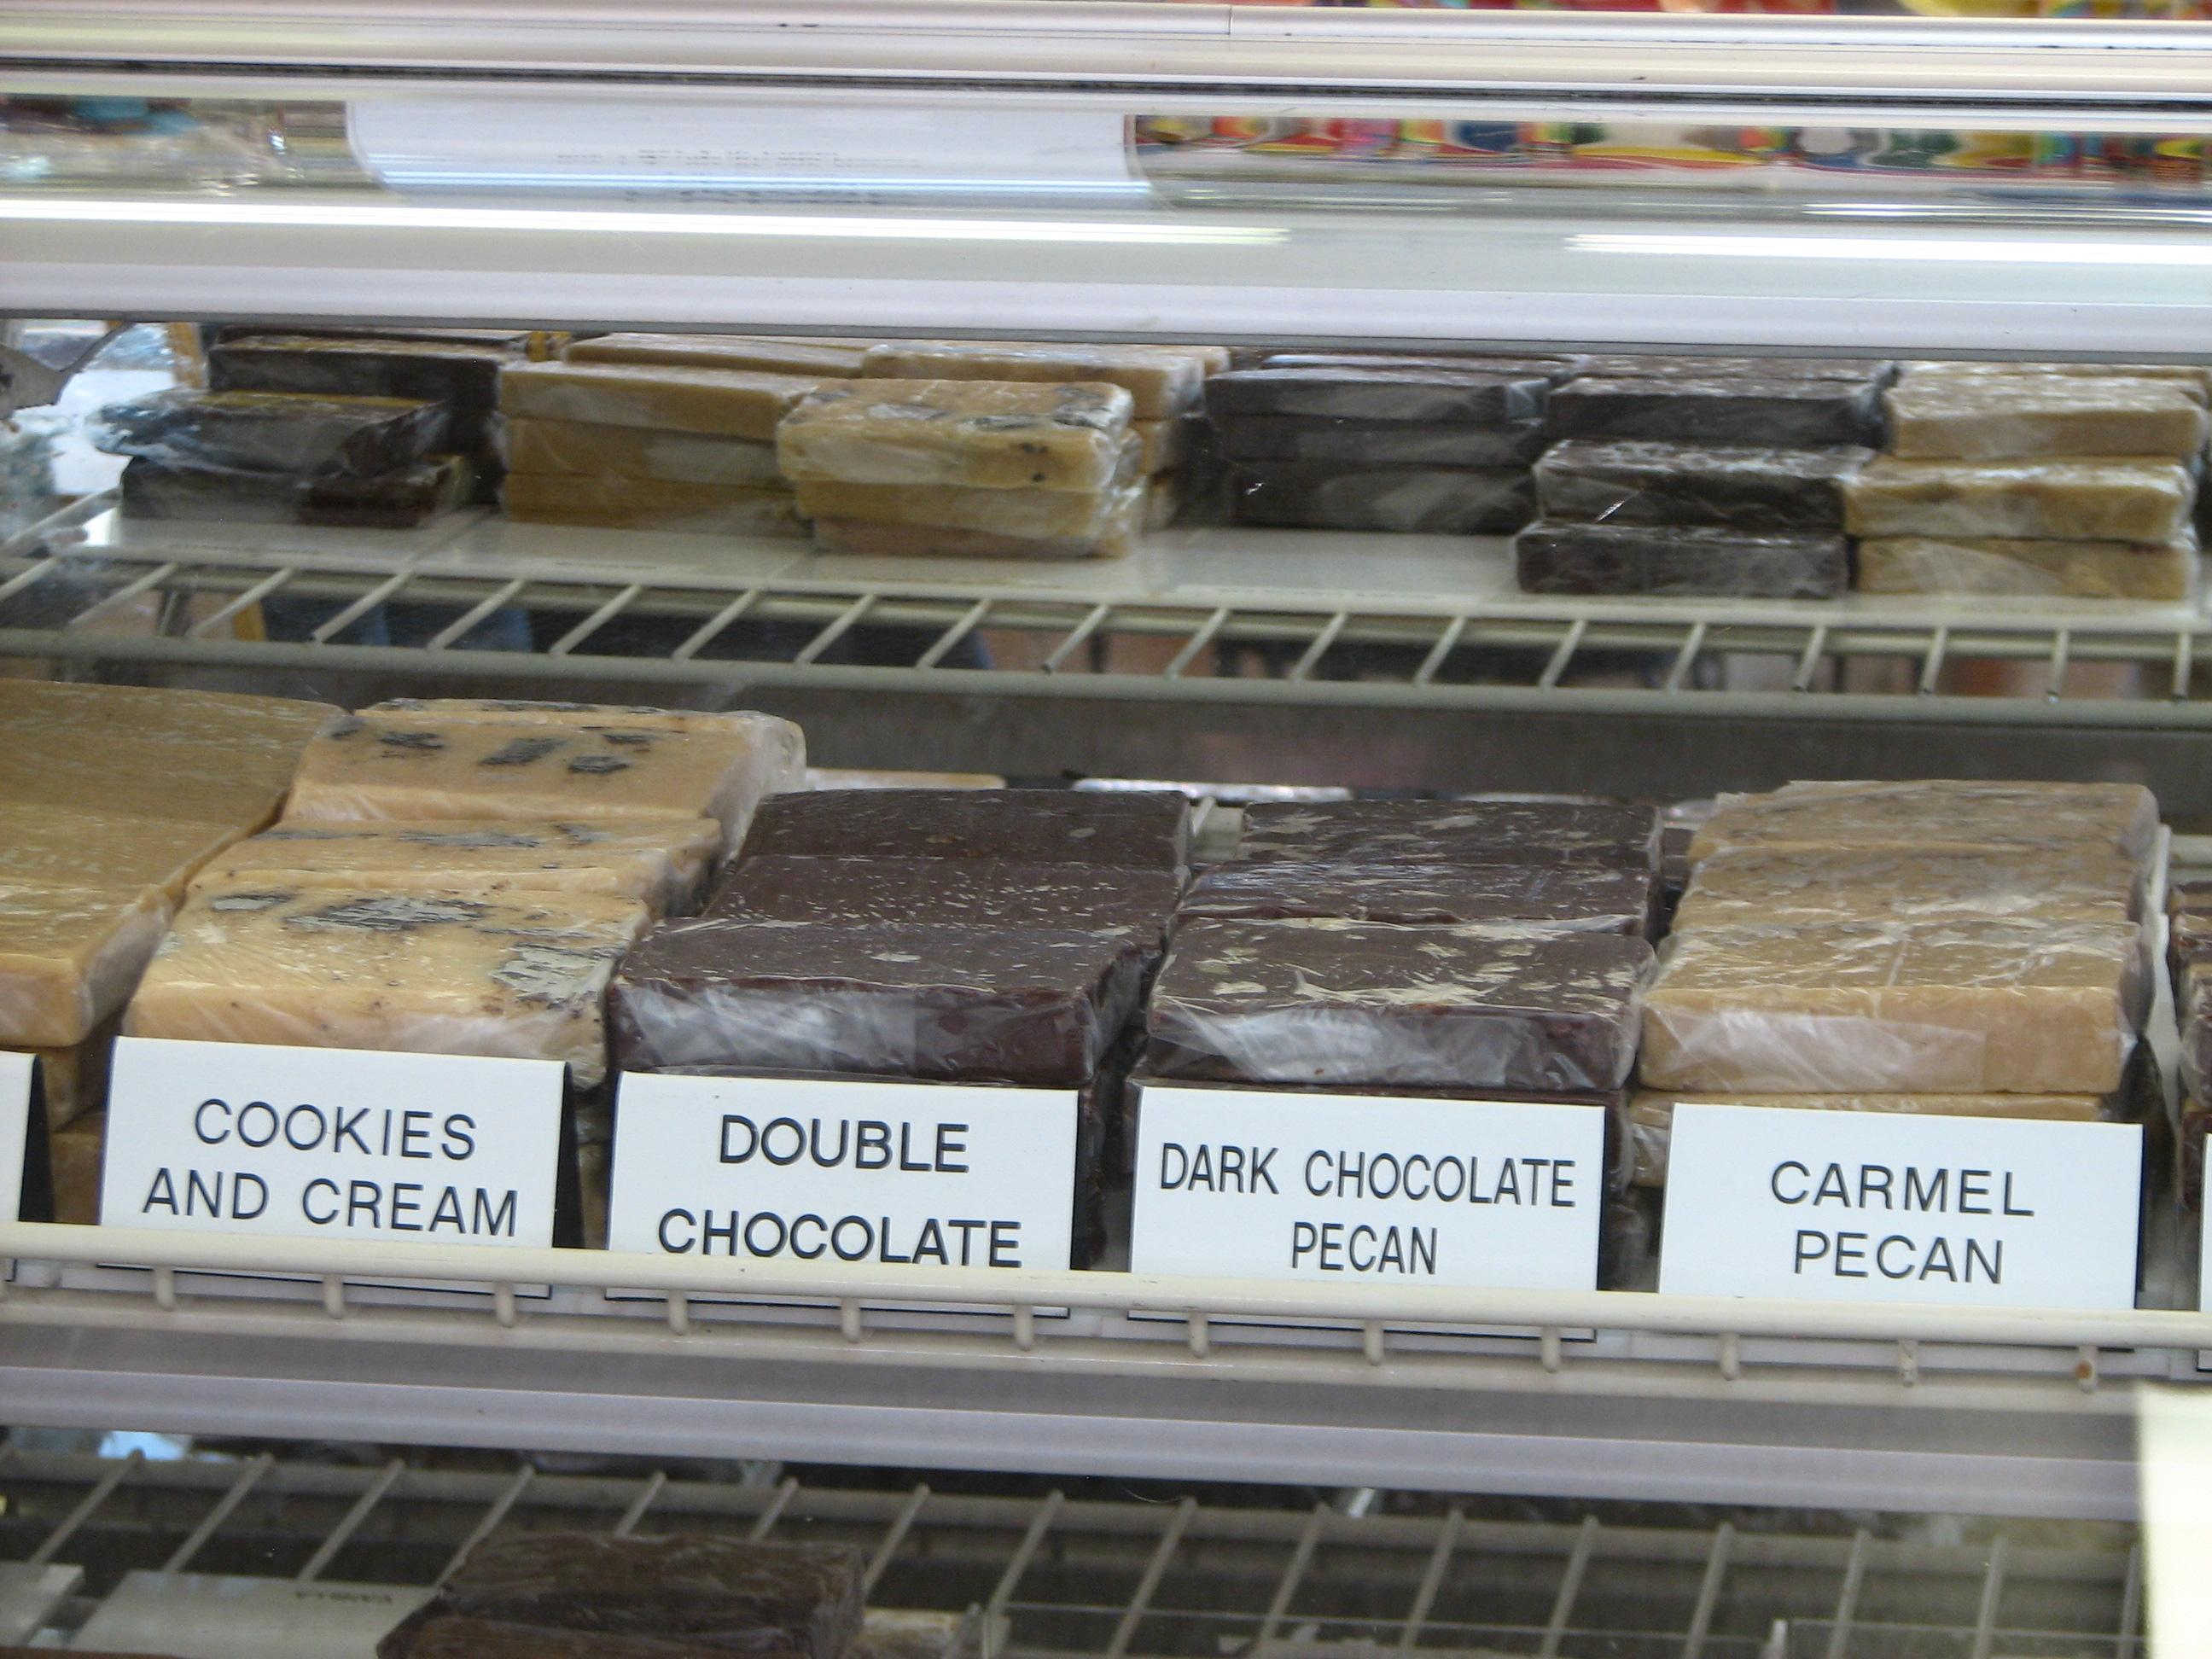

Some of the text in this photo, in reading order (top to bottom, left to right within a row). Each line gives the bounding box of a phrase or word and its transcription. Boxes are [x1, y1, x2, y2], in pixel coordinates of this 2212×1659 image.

[195, 1098, 474, 1161] COOKIES
[719, 1114, 969, 1173] DOUBLE
[143, 1167, 515, 1237] AND CREAM
[1161, 1143, 1575, 1208] DARK CHOCOLATE
[1771, 1161, 2032, 1216] CARMEL
[658, 1208, 1021, 1268] CHOCOLATE
[1292, 1221, 1435, 1275] PECAN
[1795, 1230, 2000, 1284] PECAN
